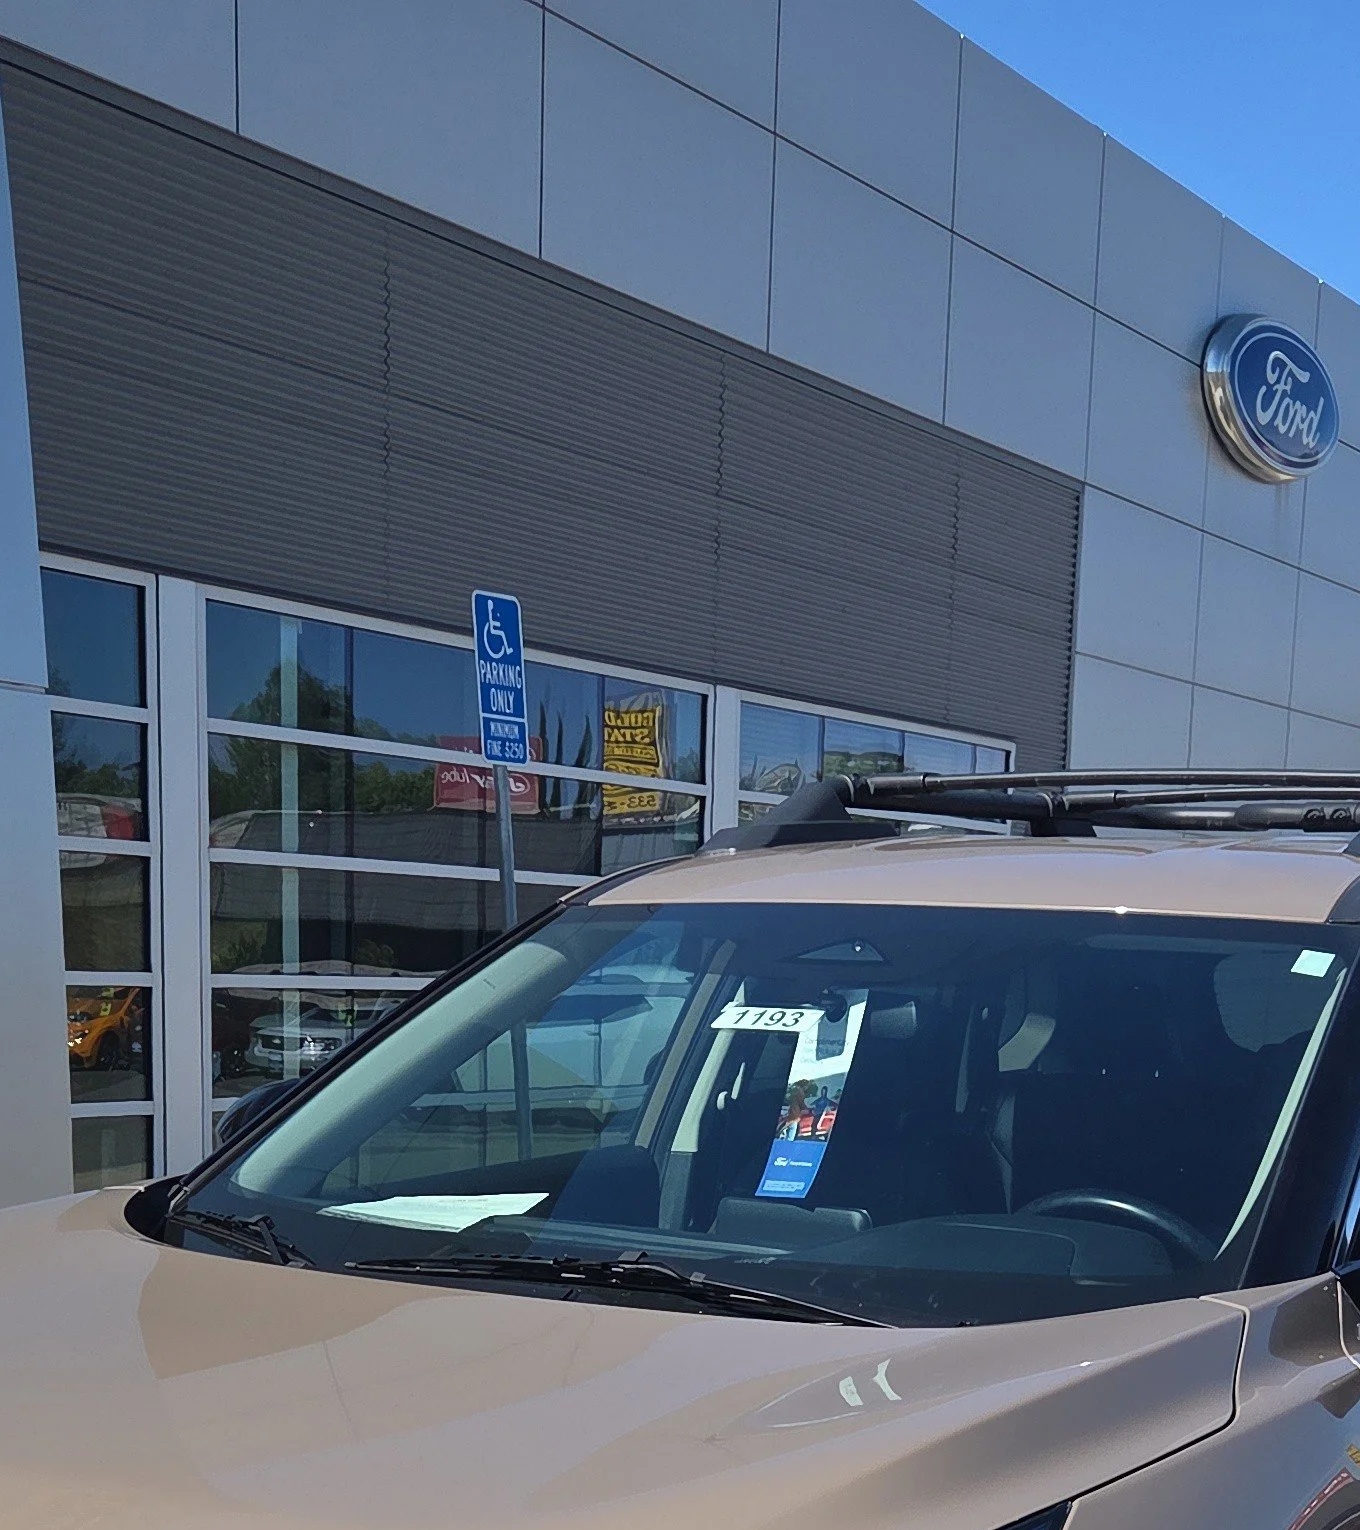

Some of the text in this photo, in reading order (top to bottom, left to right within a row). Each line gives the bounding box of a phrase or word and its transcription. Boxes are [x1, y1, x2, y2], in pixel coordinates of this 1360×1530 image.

[1256, 351, 1324, 448] Ford
[480, 660, 521, 688] PARKING
[490, 688, 514, 713] ONLY
[732, 1009, 805, 1027] 1193
